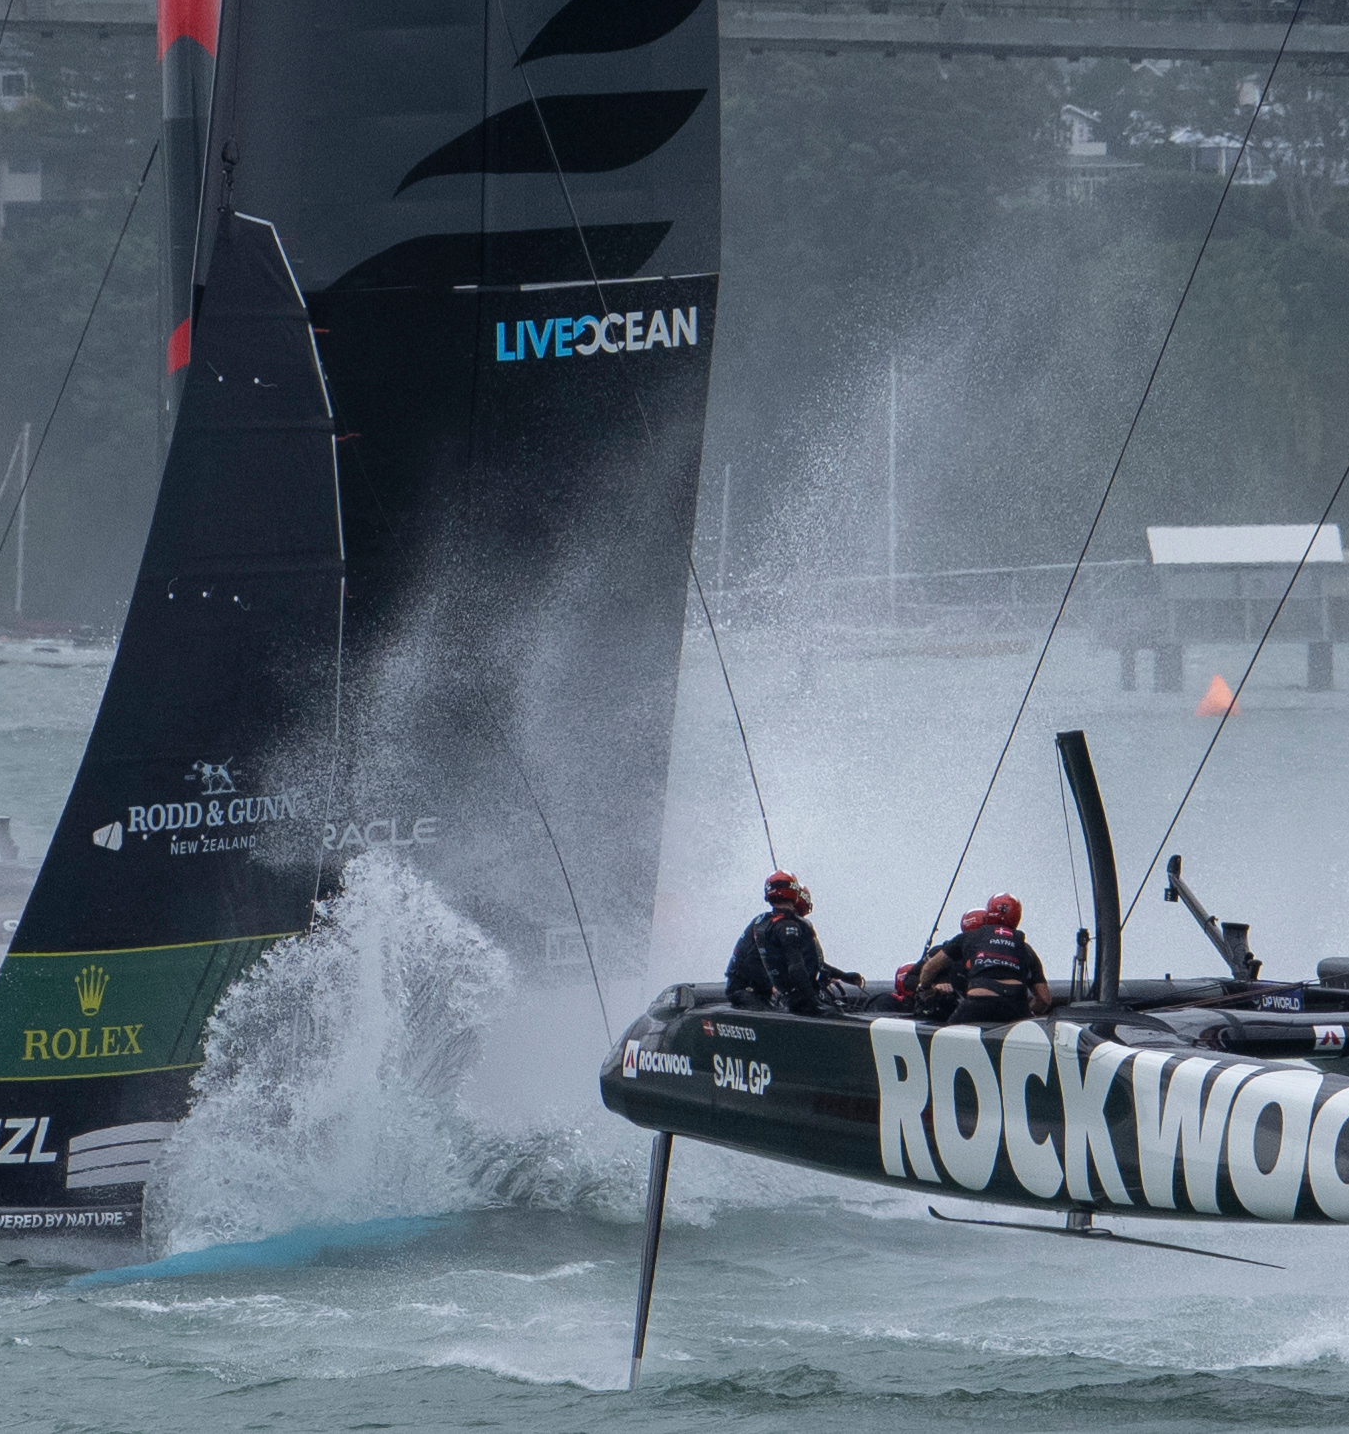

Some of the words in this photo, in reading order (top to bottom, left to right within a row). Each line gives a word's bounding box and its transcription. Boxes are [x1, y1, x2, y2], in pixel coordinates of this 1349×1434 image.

[127, 802, 203, 832] RODD
[206, 800, 224, 826] &
[228, 792, 300, 824] GUNN
[170, 841, 198, 855] NEW
[202, 835, 256, 852] ZEALAND
[322, 817, 439, 850] RACLE
[1273, 996, 1300, 1011] WORLD
[22, 1024, 143, 1060] ROLEX
[715, 1022, 756, 1041] SEHESTED
[638, 1050, 693, 1076] ROCKWOOL
[44, 1214, 64, 1228] BY
